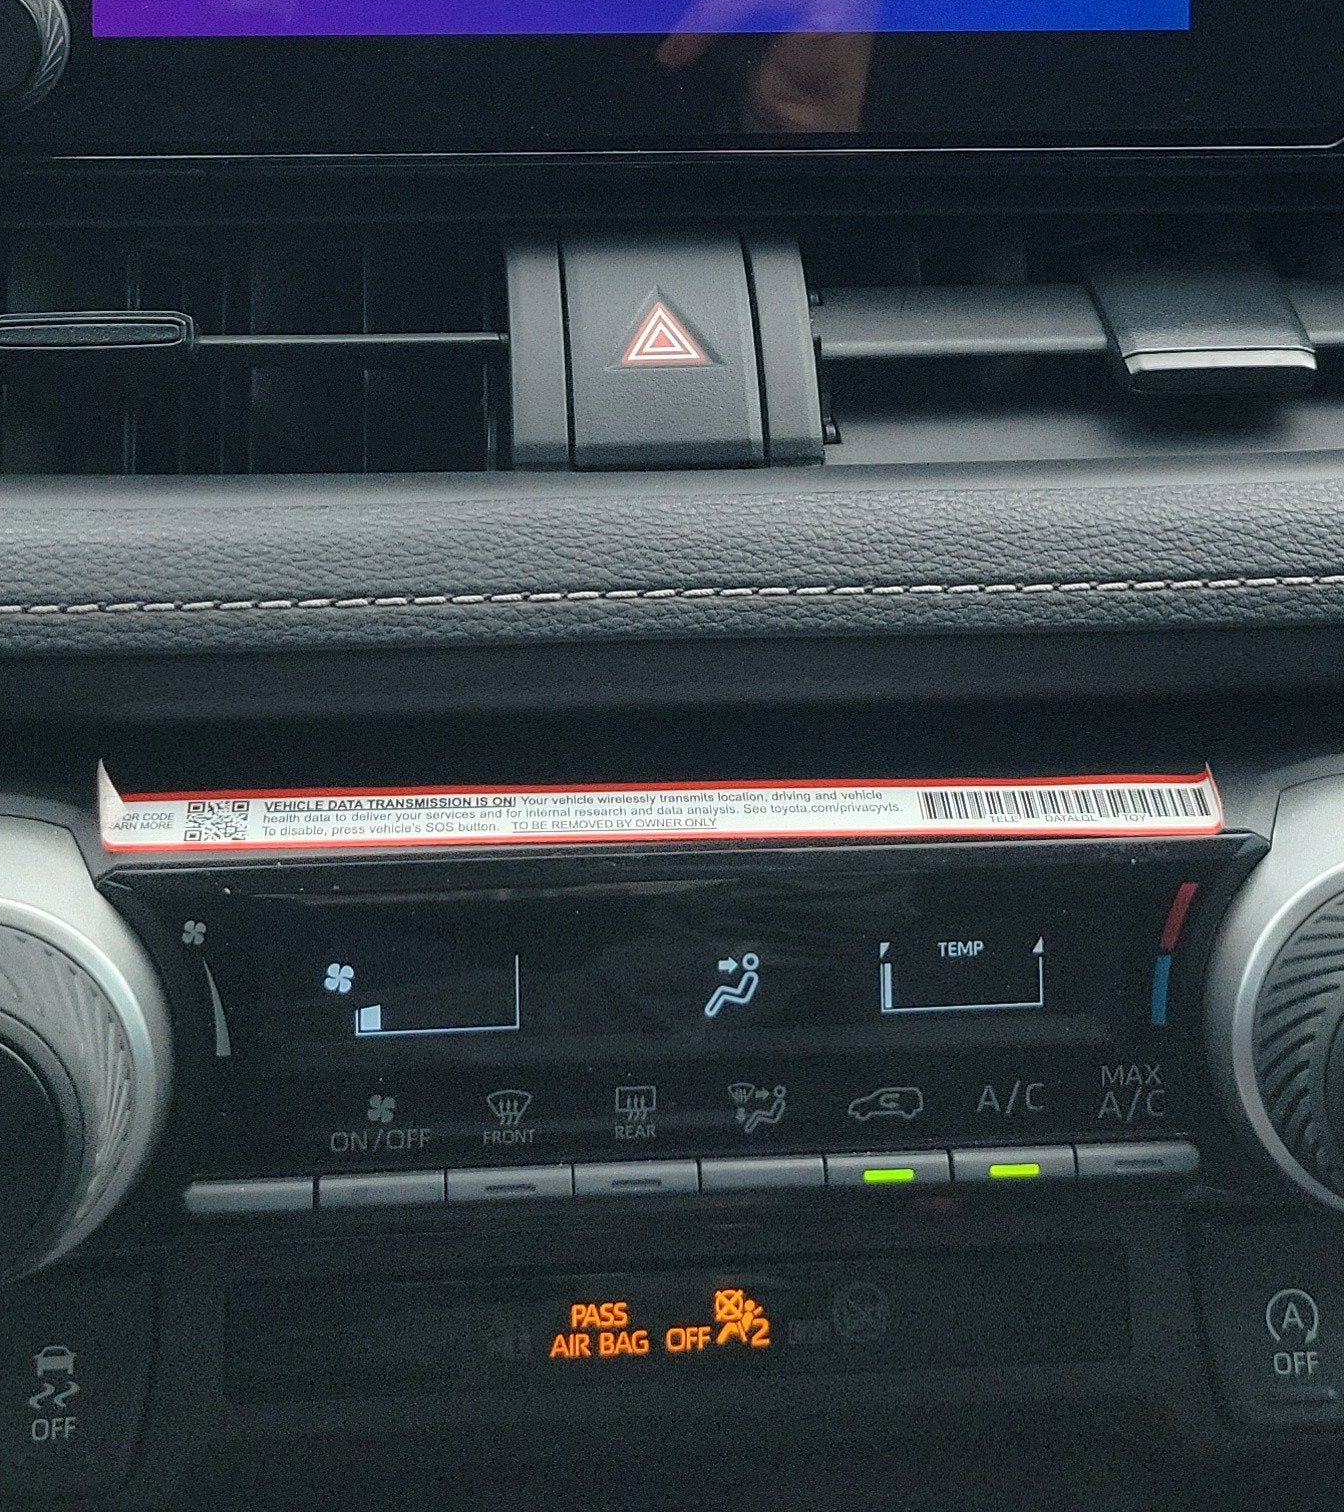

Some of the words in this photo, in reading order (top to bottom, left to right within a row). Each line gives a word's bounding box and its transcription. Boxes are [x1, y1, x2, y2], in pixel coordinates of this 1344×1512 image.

[264, 800, 324, 811] VEHICLE
[328, 799, 363, 810] DATA
[368, 797, 472, 809] TRANSMISSION
[476, 797, 488, 807] IS
[521, 796, 548, 806] Your
[552, 795, 594, 805] vehicle
[597, 794, 656, 806] wirelessly
[659, 792, 714, 803] transmits
[717, 791, 768, 804] location,
[771, 791, 811, 804] driving
[815, 791, 837, 801] and
[841, 790, 883, 800] vehicle
[142, 812, 175, 821] CODE
[263, 812, 300, 824] health
[304, 812, 331, 823] data
[335, 812, 347, 822] to
[351, 810, 391, 821] deliver
[395, 811, 422, 824] your
[425, 809, 476, 820] services
[479, 808, 502, 819] and
[506, 807, 522, 818] for
[526, 807, 571, 818] internal
[574, 806, 627, 817] research
[631, 805, 654, 816] and
[657, 804, 683, 815] data
[687, 803, 740, 816] analysis.
[743, 803, 767, 814] See
[1122, 813, 1147, 822] TOY
[140, 820, 174, 830] MORE
[262, 826, 276, 837] To
[280, 825, 328, 837] disable,
[331, 825, 365, 838] press
[369, 823, 422, 834] vehicle's
[425, 822, 454, 833] SOS
[458, 821, 500, 832] button.
[512, 821, 529, 831] TO
[532, 820, 548, 830] BE
[552, 819, 613, 829] REMOVED
[616, 819, 632, 828] BY
[635, 818, 682, 828] OWNER
[685, 817, 717, 827] ONLY
[937, 940, 985, 957] TEMP
[1101, 1063, 1162, 1087] MAX
[976, 1080, 1046, 1114] A/C
[1097, 1087, 1166, 1124] A/C
[330, 1128, 431, 1153] ON/OFF
[482, 1129, 536, 1146] FRONT
[614, 1124, 657, 1140] REAR
[570, 1301, 629, 1329] PASS
[549, 1332, 592, 1358] AIR
[599, 1329, 650, 1357] BAG
[665, 1325, 712, 1353] OFF
[1273, 1351, 1320, 1375] OFF
[31, 1416, 77, 1441] OFF
